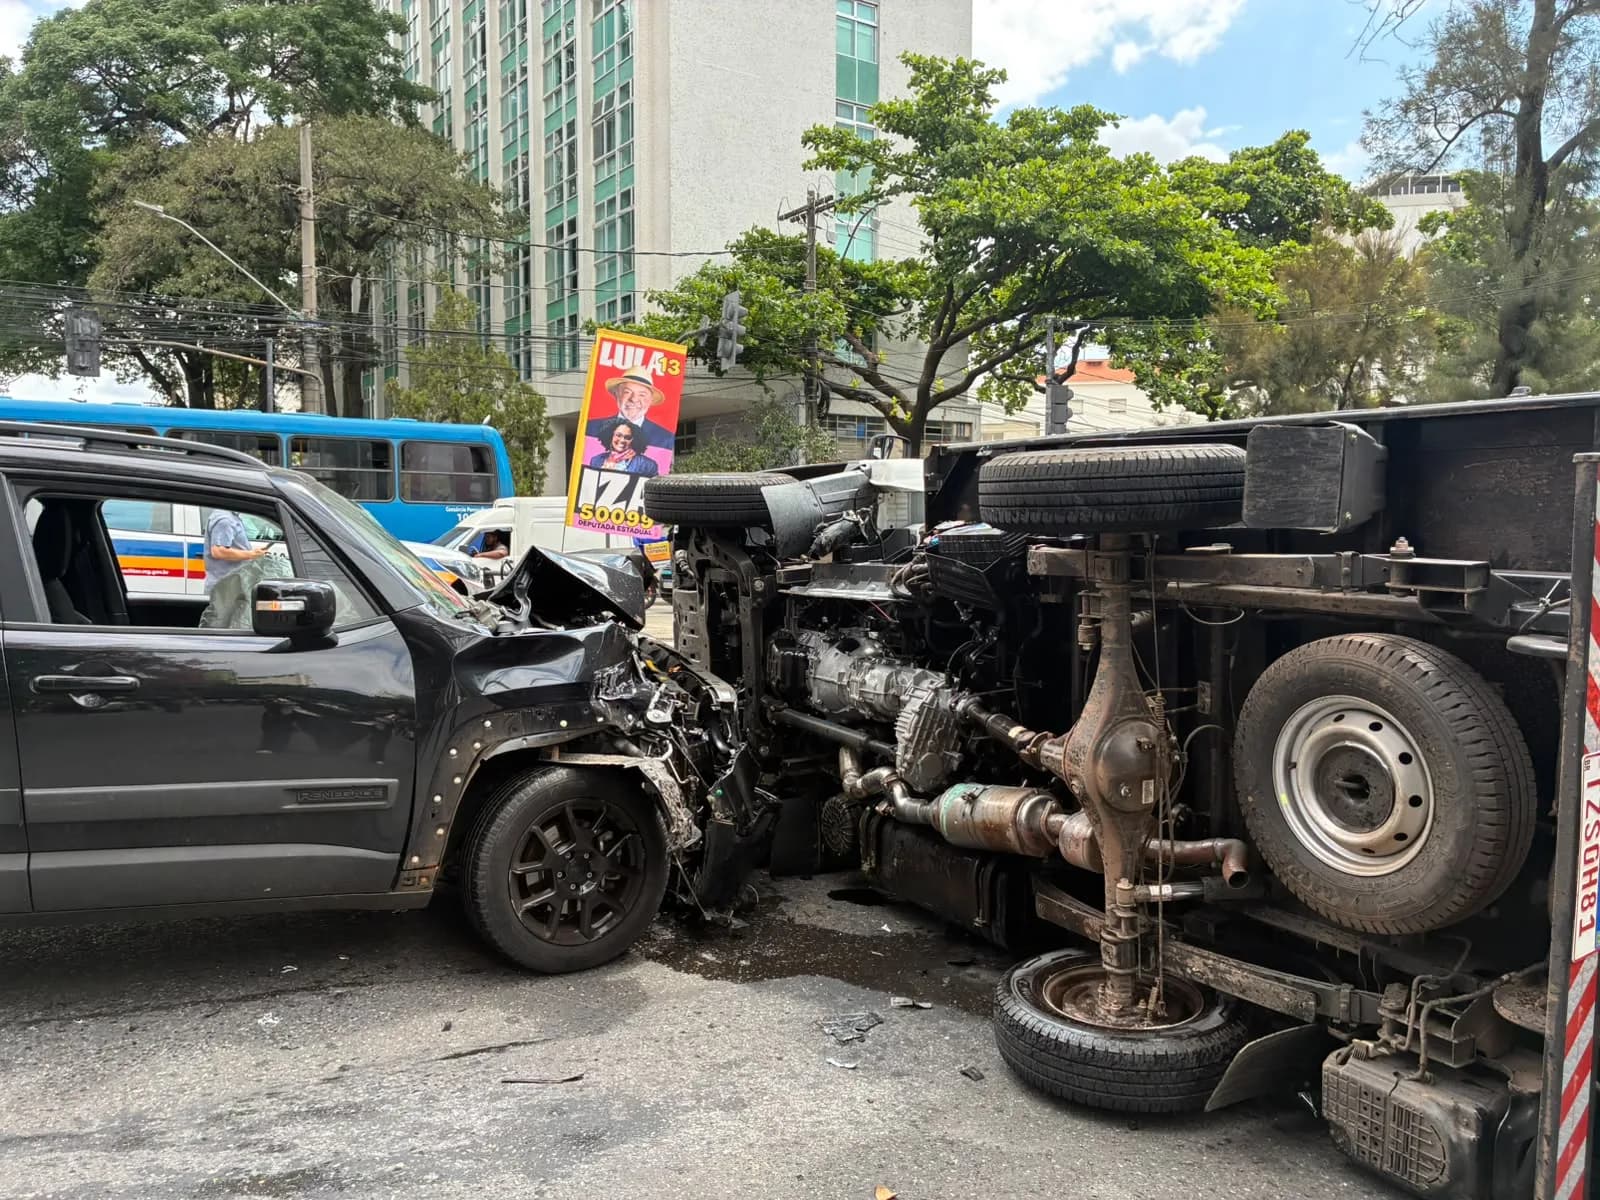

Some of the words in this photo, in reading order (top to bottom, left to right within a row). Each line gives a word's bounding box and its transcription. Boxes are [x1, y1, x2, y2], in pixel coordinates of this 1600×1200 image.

[599, 341, 664, 376] LULA
[658, 356, 681, 376] 13
[579, 503, 655, 529] 50099
[578, 519, 616, 531] DEPUTADA
[616, 525, 652, 536] ESTADUAL
[1584, 760, 1591, 771] BR
